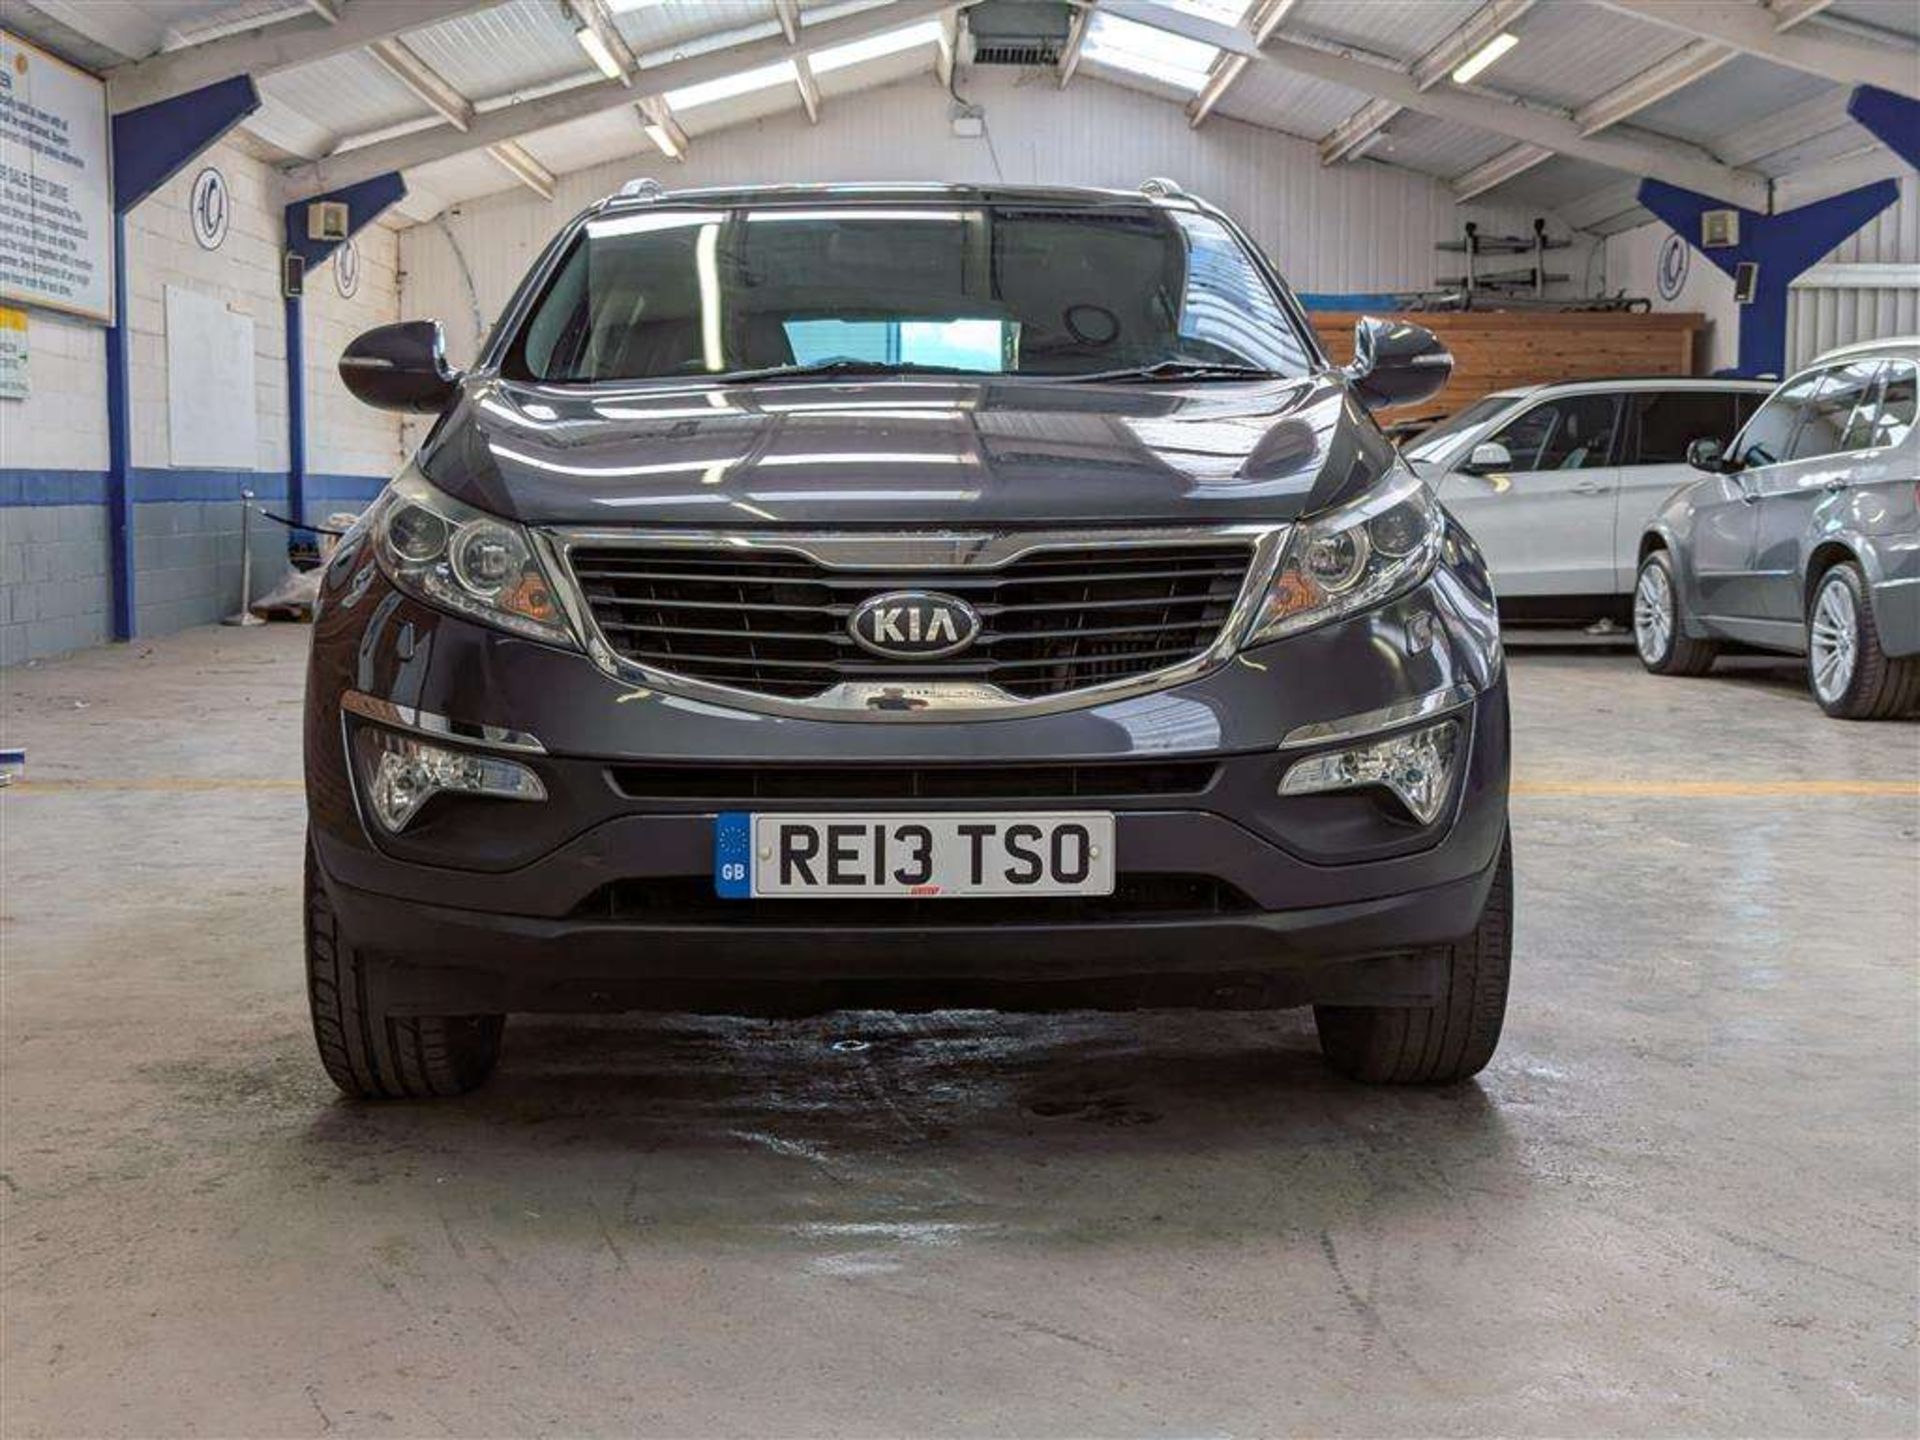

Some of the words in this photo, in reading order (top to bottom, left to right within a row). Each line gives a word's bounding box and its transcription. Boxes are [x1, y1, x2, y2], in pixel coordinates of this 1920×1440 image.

[873, 607, 958, 643] KIA
[721, 863, 745, 881] GB
[778, 824, 933, 886] RE13
[957, 824, 1090, 886] TSO
